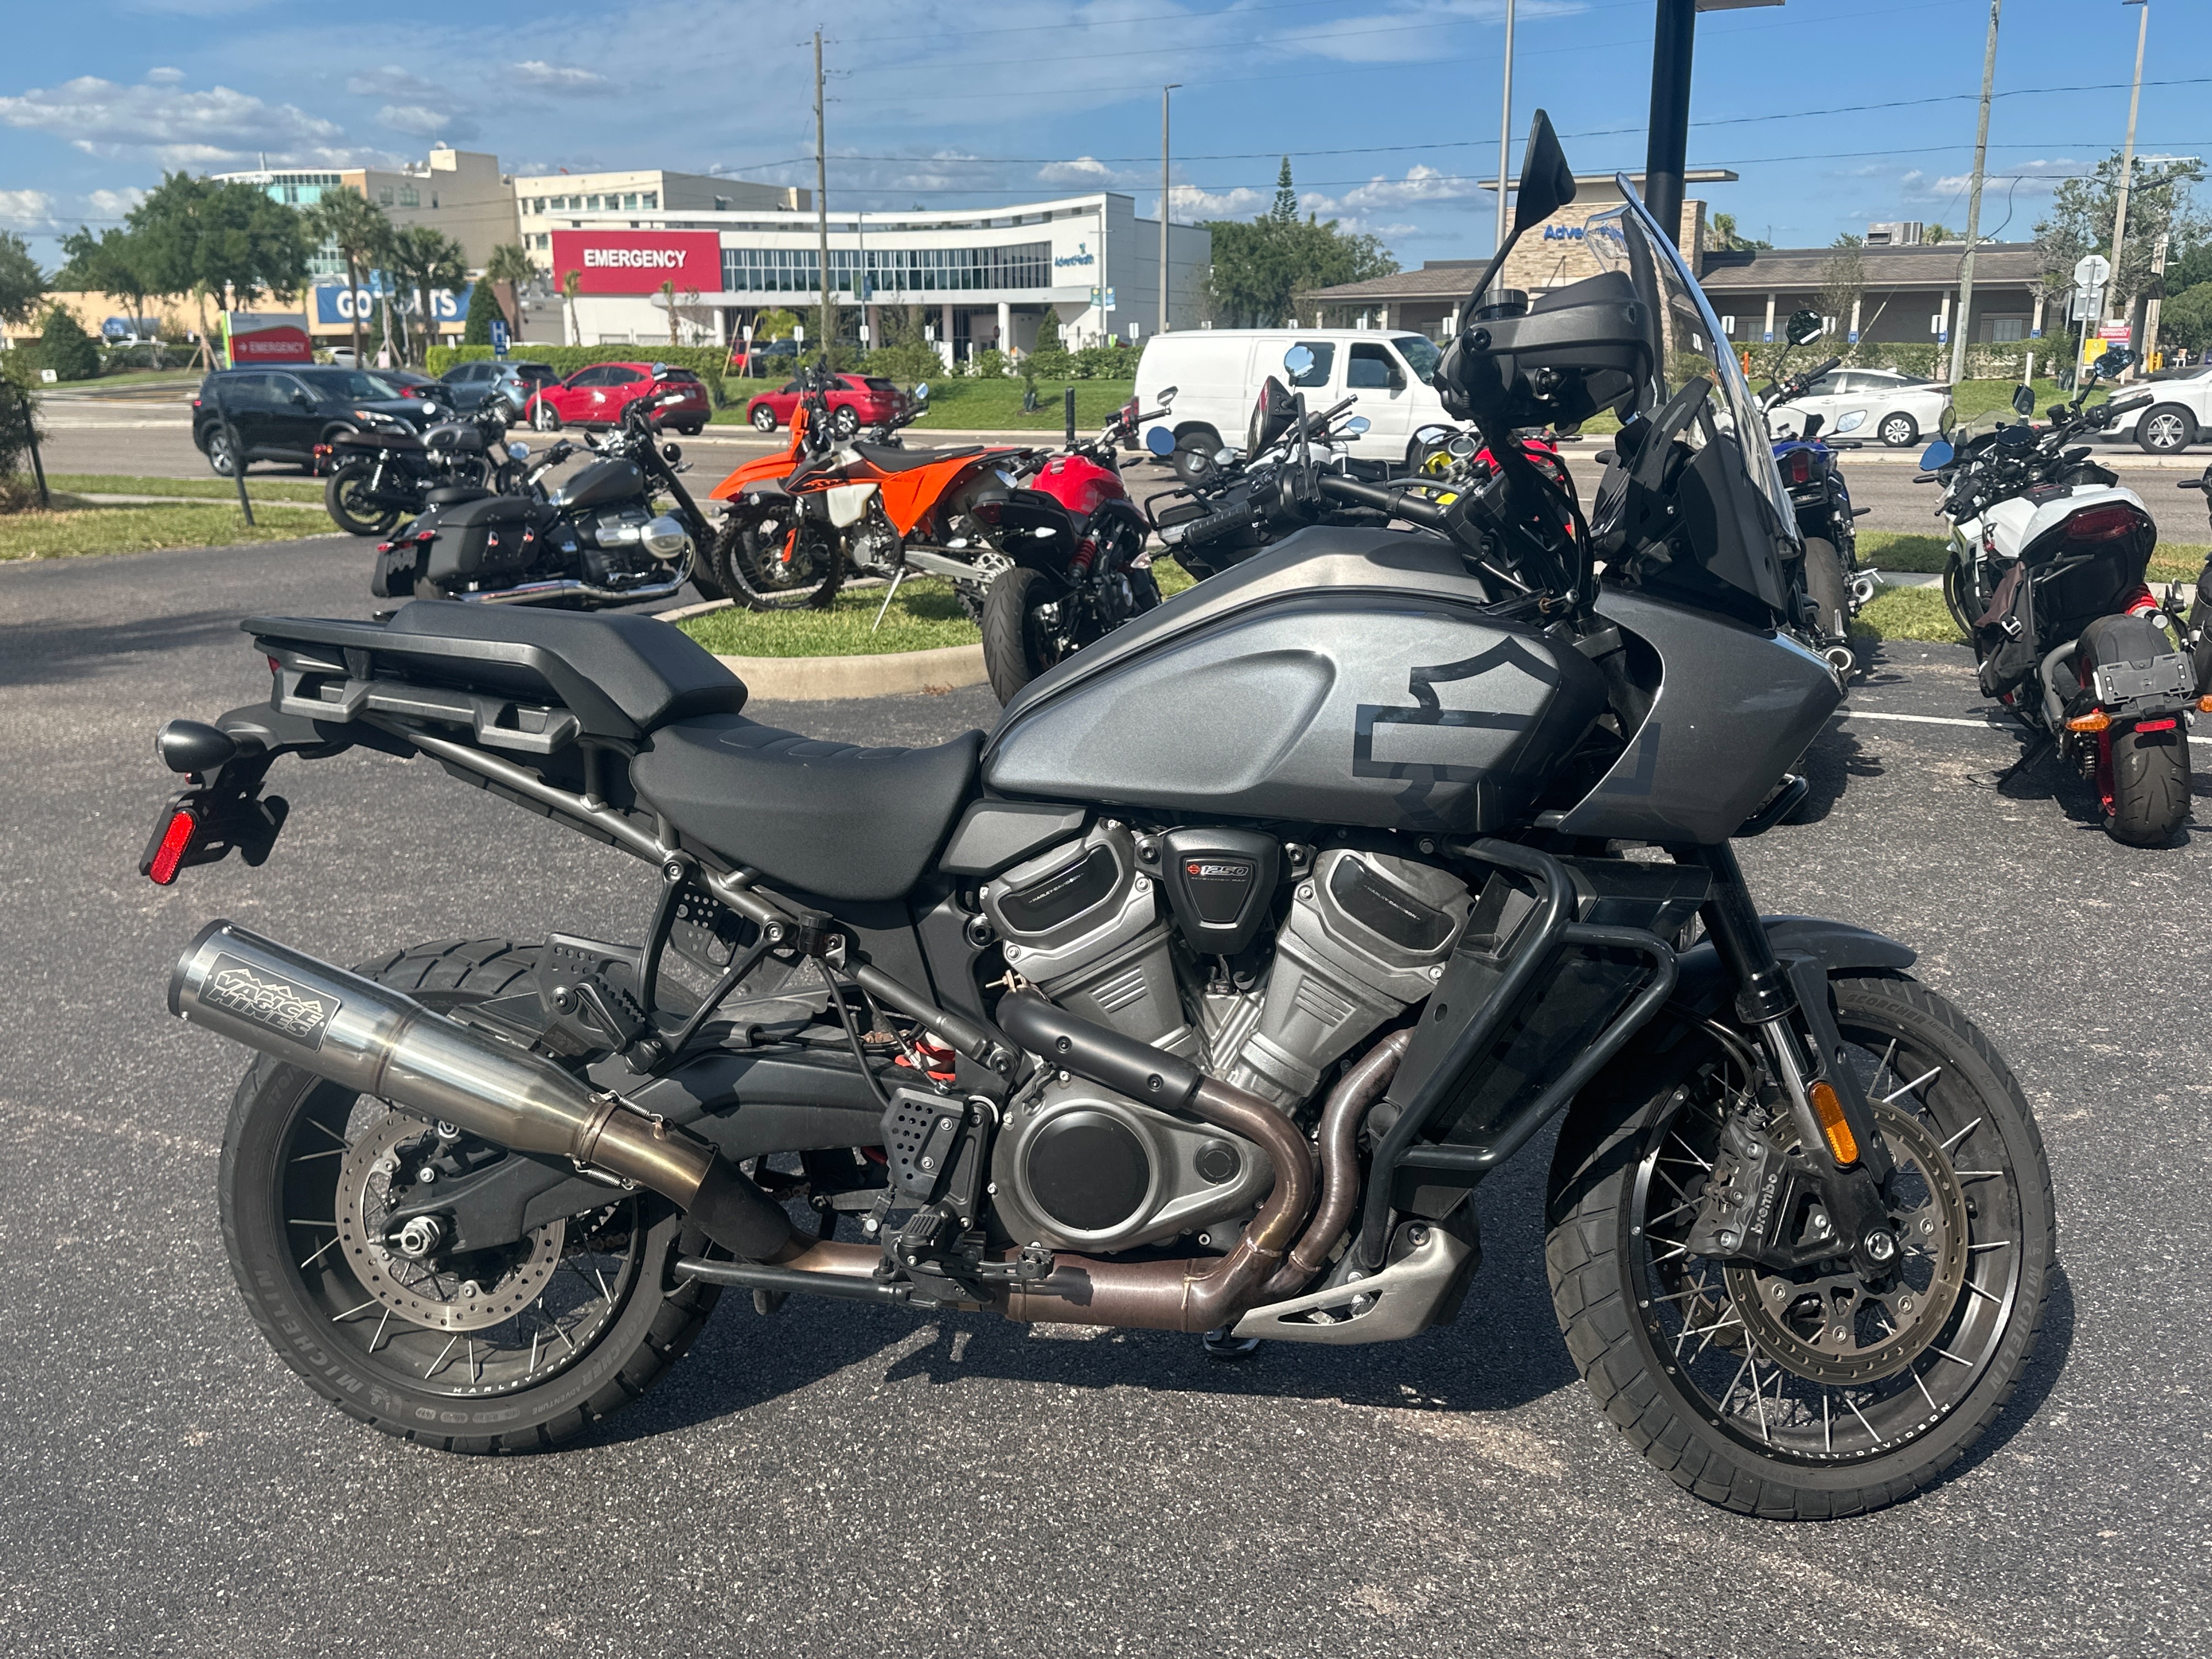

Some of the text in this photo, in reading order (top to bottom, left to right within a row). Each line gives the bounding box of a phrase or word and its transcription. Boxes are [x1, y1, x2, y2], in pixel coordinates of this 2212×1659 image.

[584, 249, 687, 268] EMERGENCY
[336, 290, 373, 319] GO
[249, 341, 305, 354] EMERGENCY
[1032, 874, 1081, 902] HARLEY-DAVIDSON
[1200, 865, 1249, 877] 1250
[1367, 887, 1417, 918] HARLEY-DAVIDSON
[206, 988, 312, 1038] HINES
[215, 972, 325, 1027] VANCE
[1751, 1173, 1778, 1235] brembo
[254, 1269, 364, 1394] MICHELIN
[453, 1293, 620, 1393] HARLEY-DAVIDSON
[1988, 1263, 2041, 1391] MICHELIN
[1763, 1403, 1951, 1459] HARLEY-DAVIDSON
